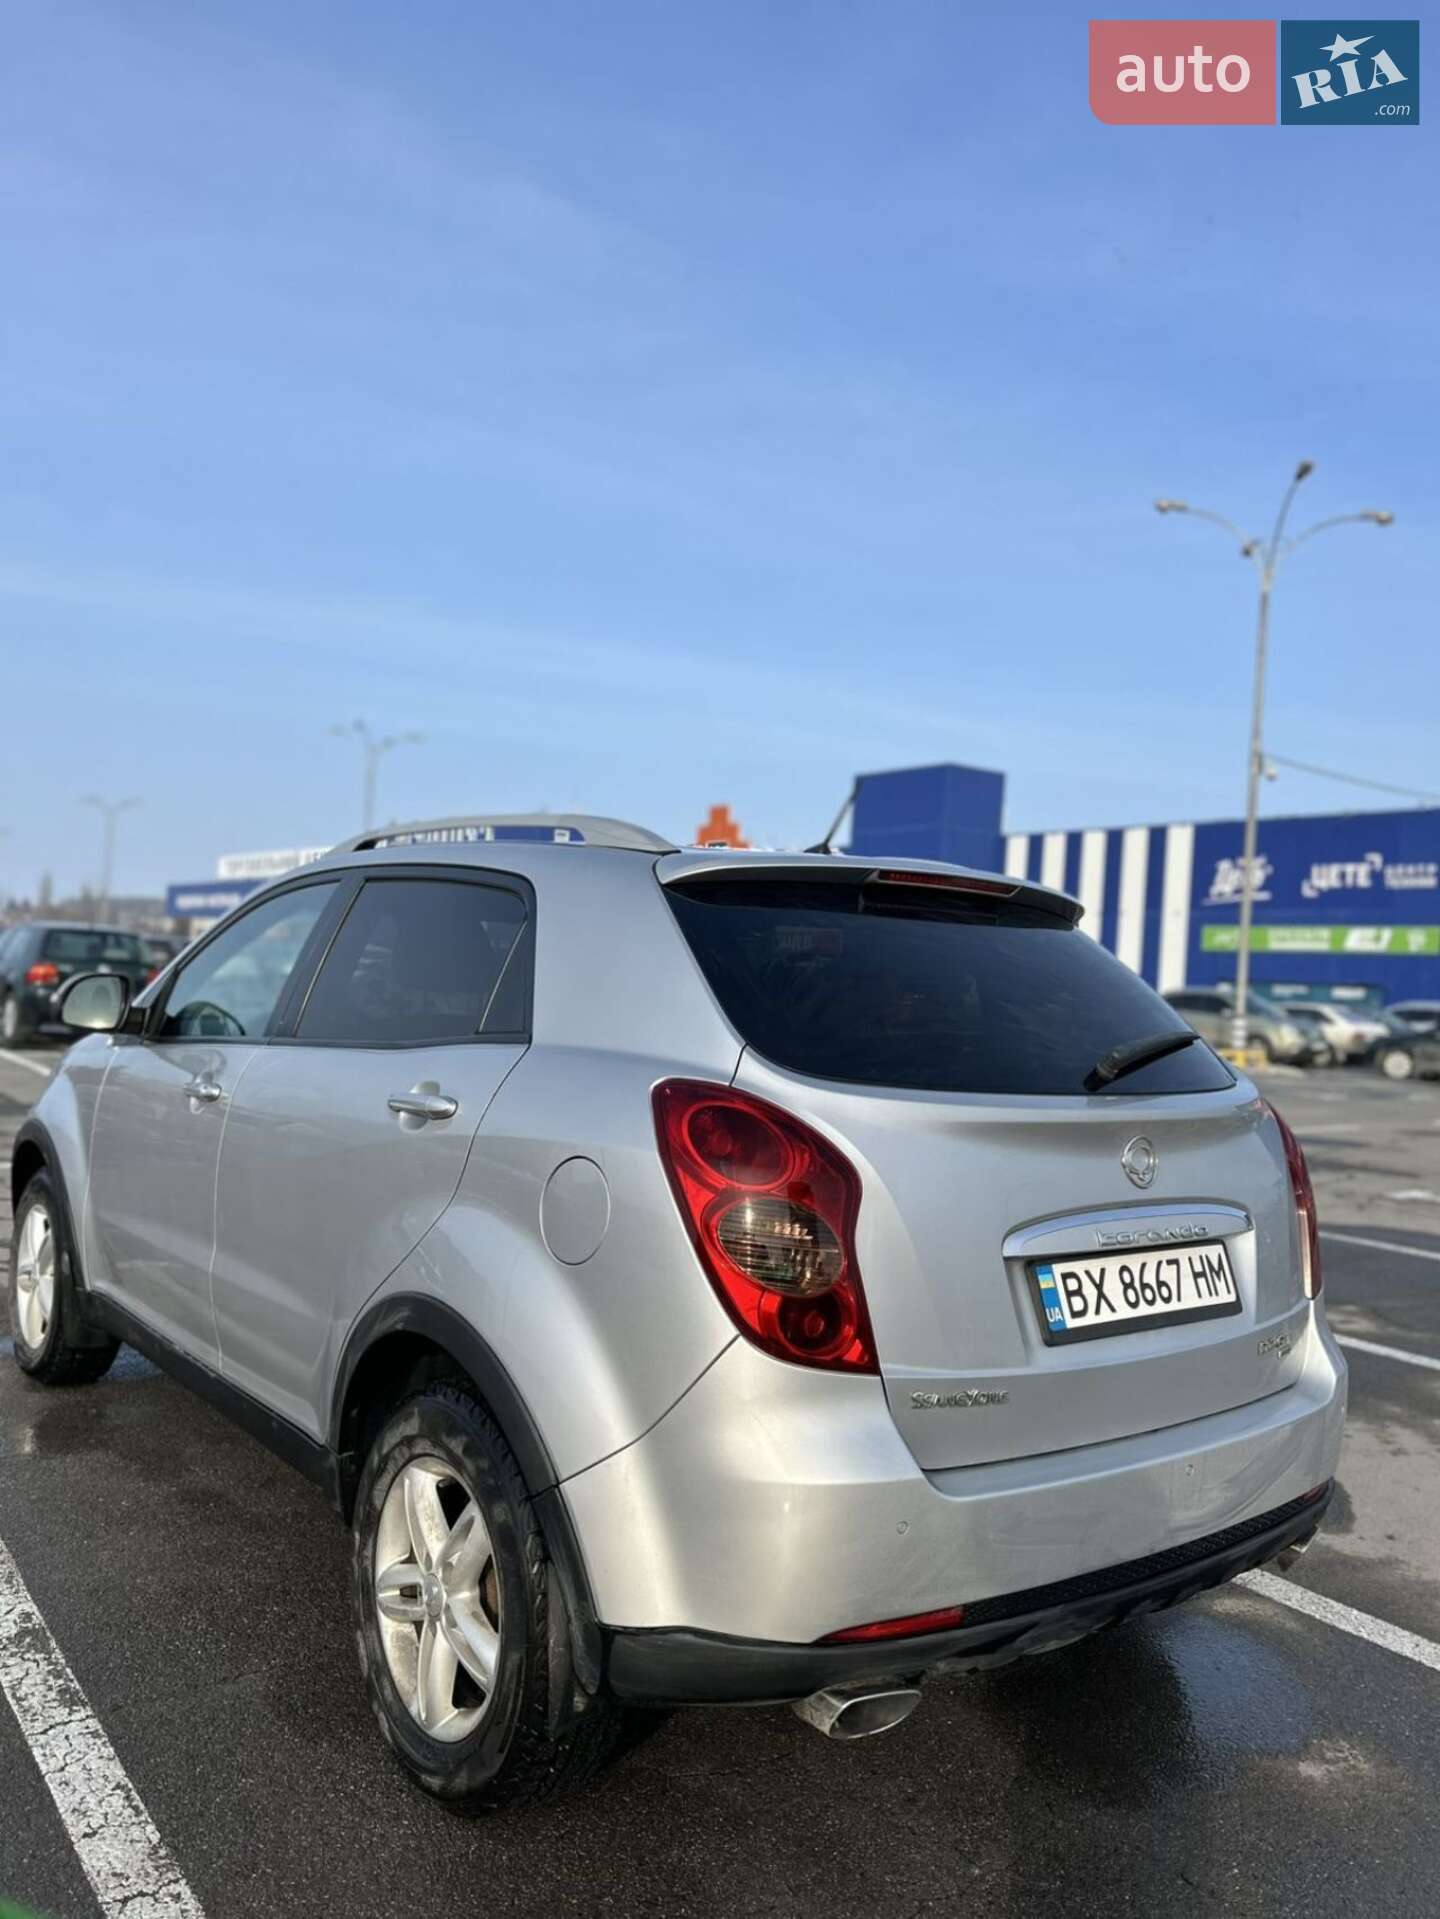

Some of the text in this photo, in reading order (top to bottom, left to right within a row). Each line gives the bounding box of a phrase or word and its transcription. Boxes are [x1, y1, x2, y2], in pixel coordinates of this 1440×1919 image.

[1060, 1252, 1232, 1319] BX 8667 HM
[1045, 1306, 1064, 1322] UA
